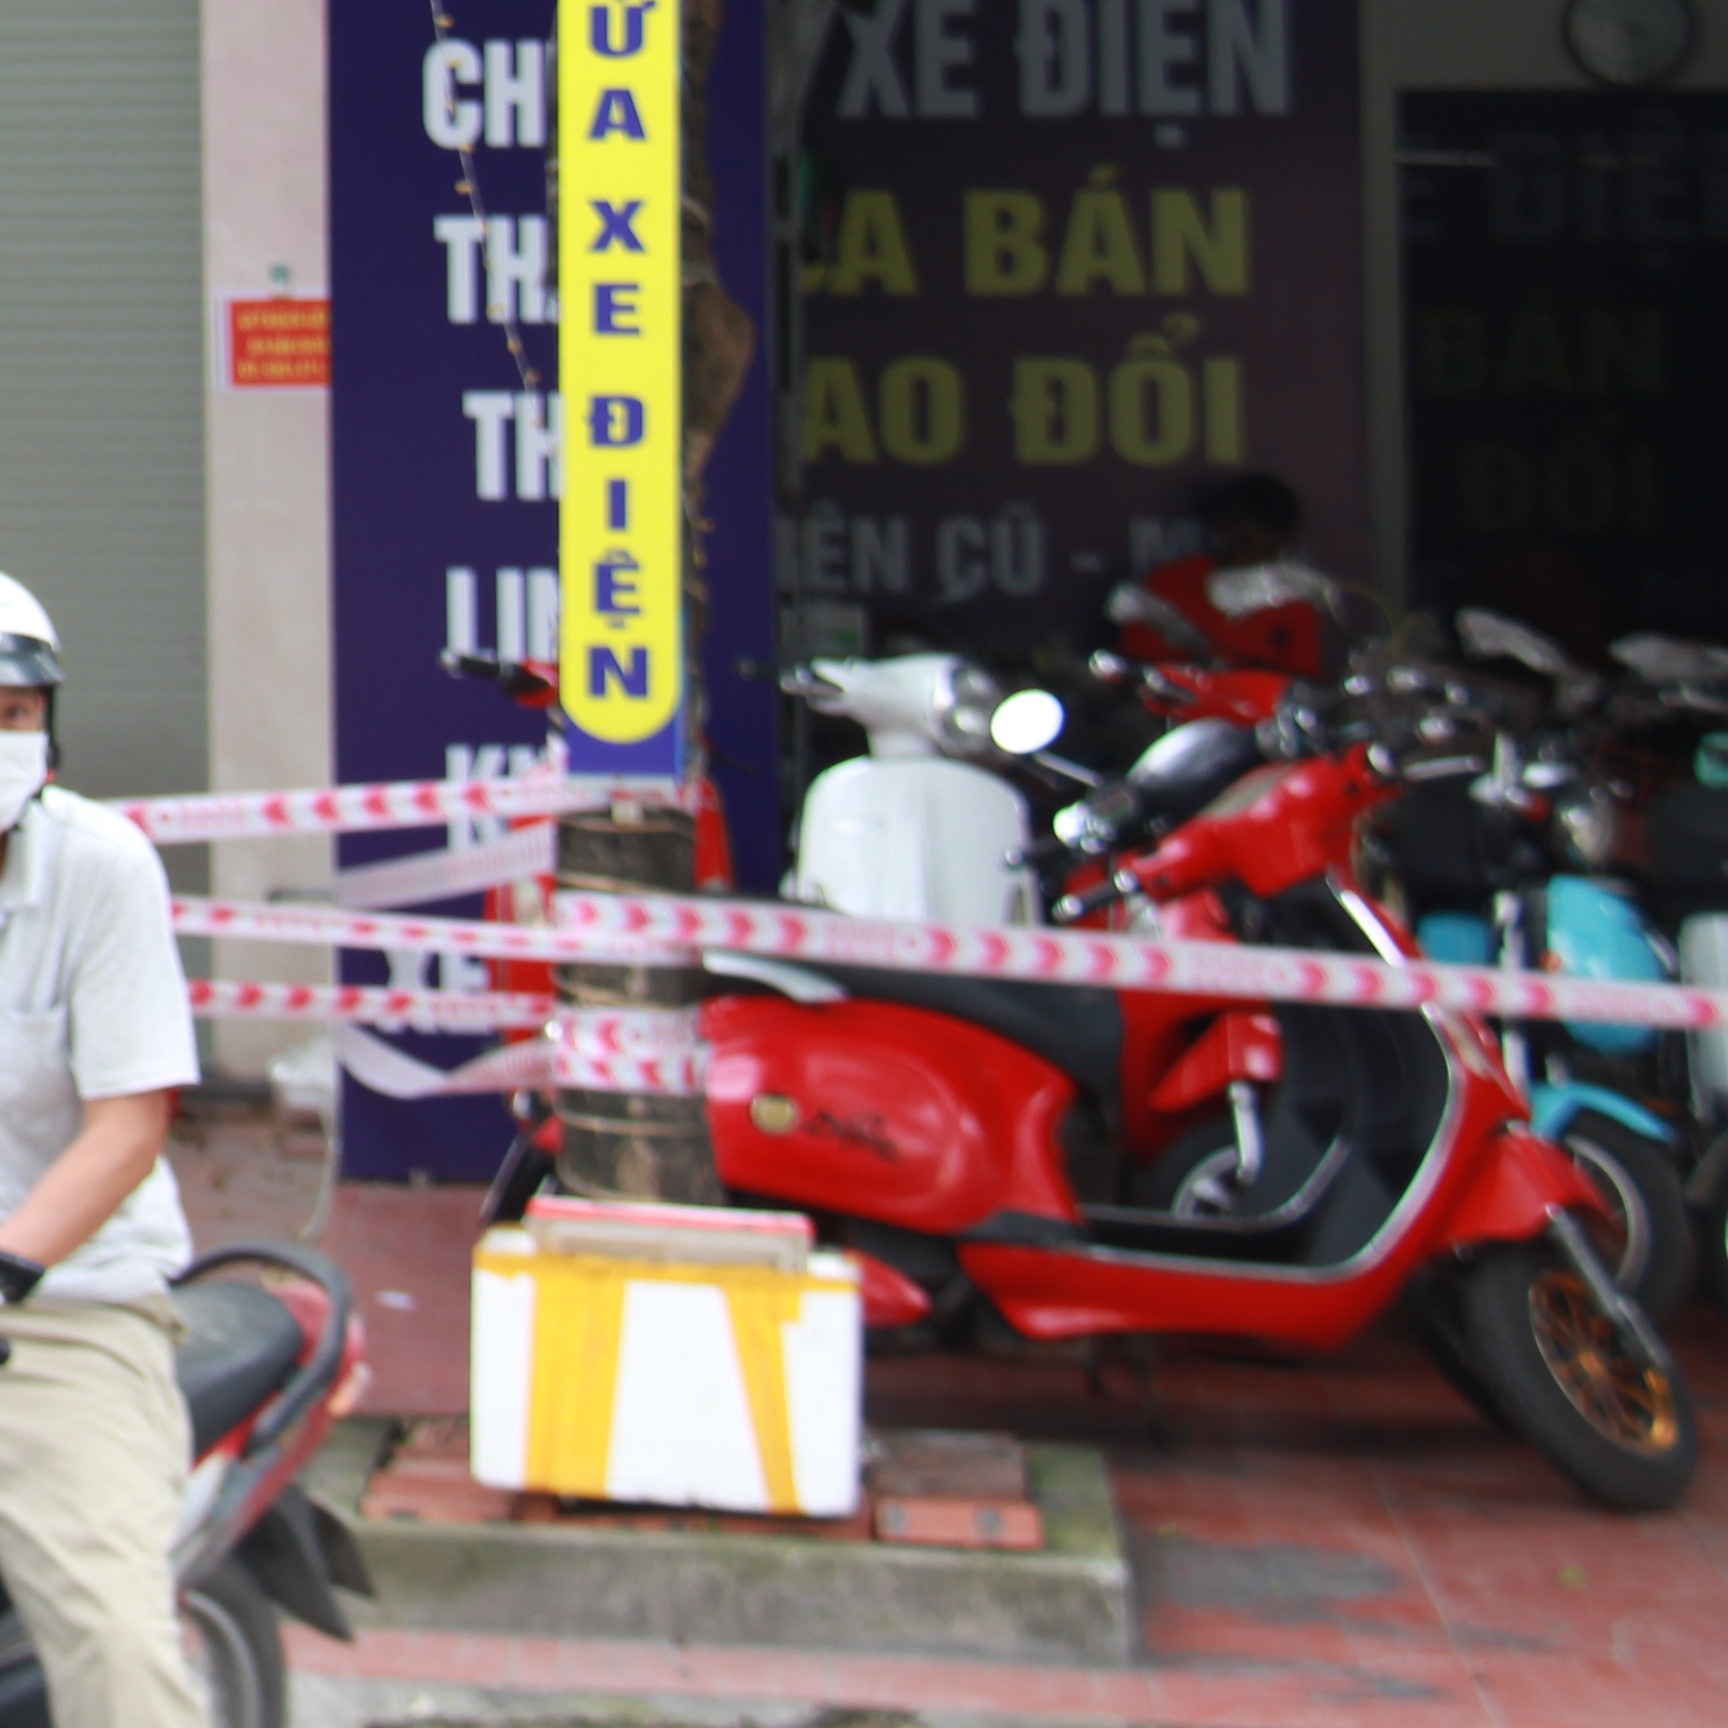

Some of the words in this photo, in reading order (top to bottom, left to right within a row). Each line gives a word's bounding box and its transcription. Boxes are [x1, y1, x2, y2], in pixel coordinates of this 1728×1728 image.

[587, 199, 647, 335] XE
[961, 162, 1253, 299] BÁN
[803, 355, 965, 465] AO
[1008, 312, 1247, 467] ĐỔI
[586, 394, 650, 699] ĐIỆN
